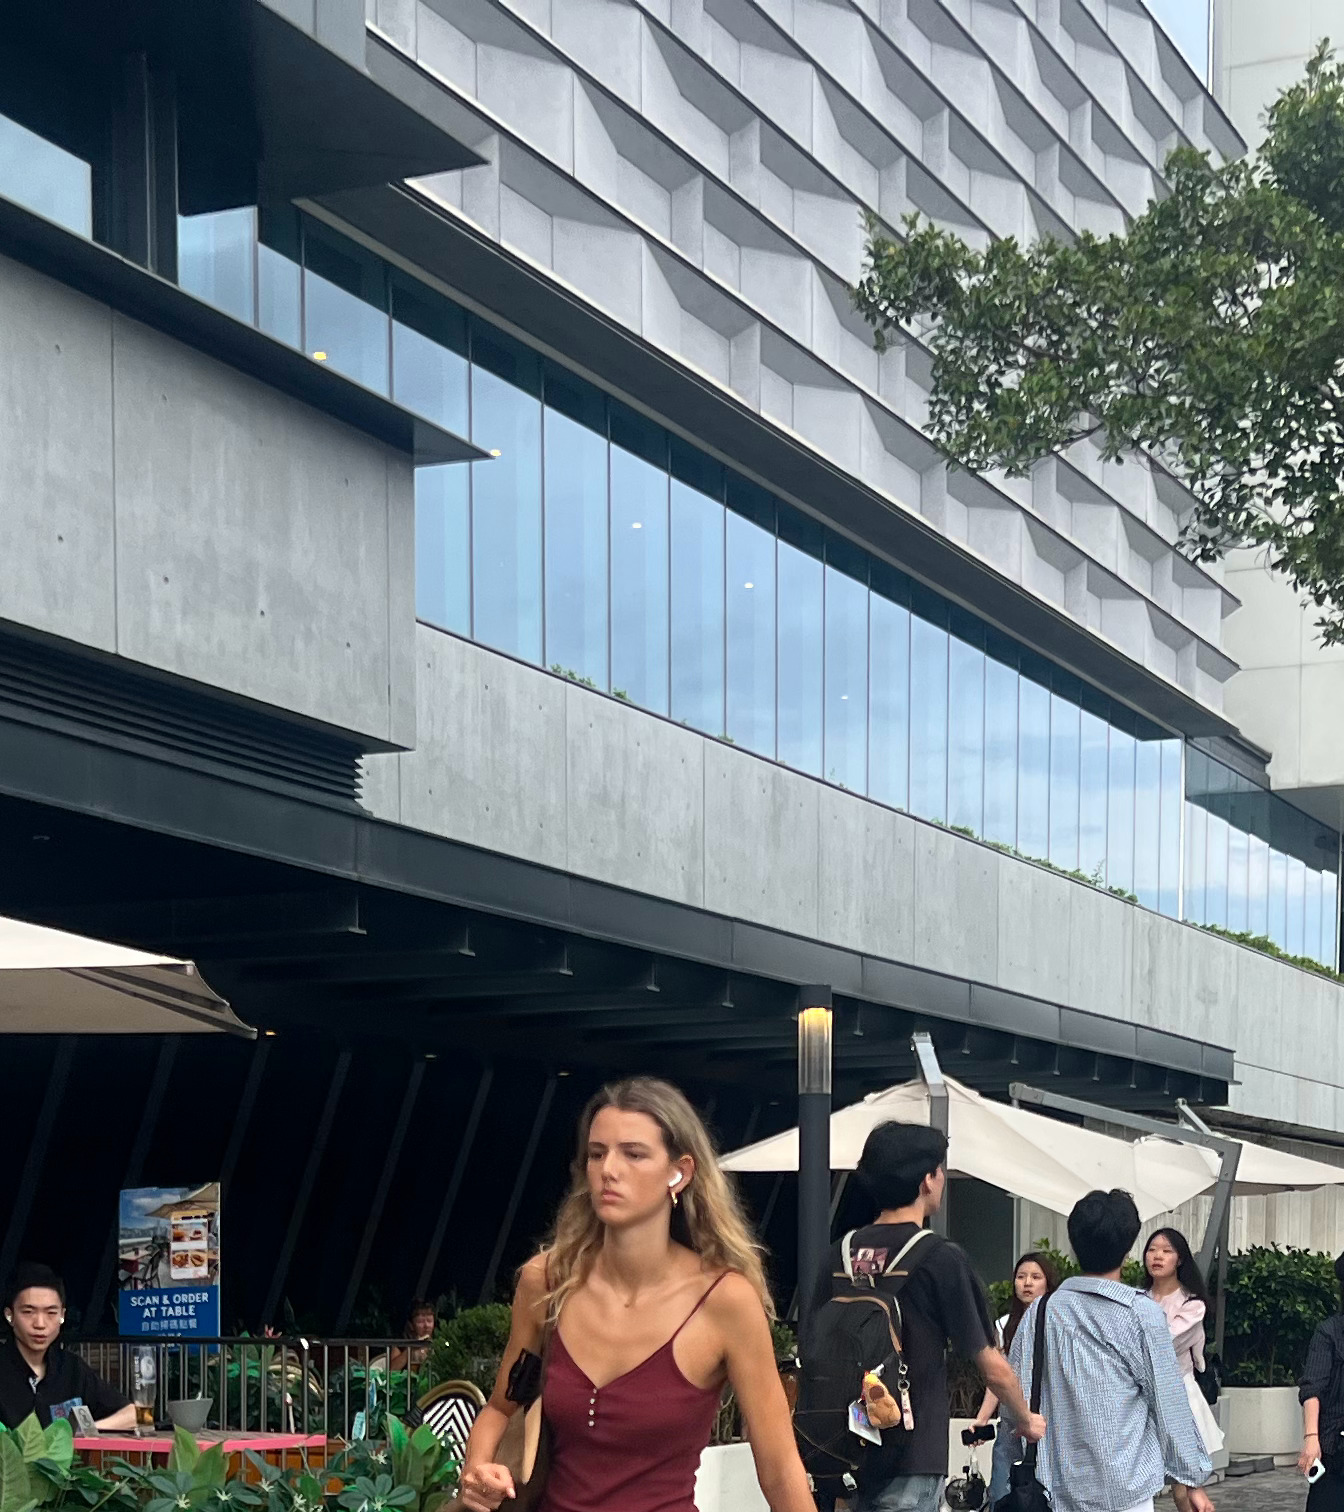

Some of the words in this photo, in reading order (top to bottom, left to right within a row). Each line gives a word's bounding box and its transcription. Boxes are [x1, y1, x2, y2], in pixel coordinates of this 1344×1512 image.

[130, 1295, 160, 1307] SCAN
[162, 1294, 171, 1305] &
[172, 1292, 209, 1304] ORDER
[142, 1307, 157, 1318] AT
[160, 1304, 196, 1317] TABLE
